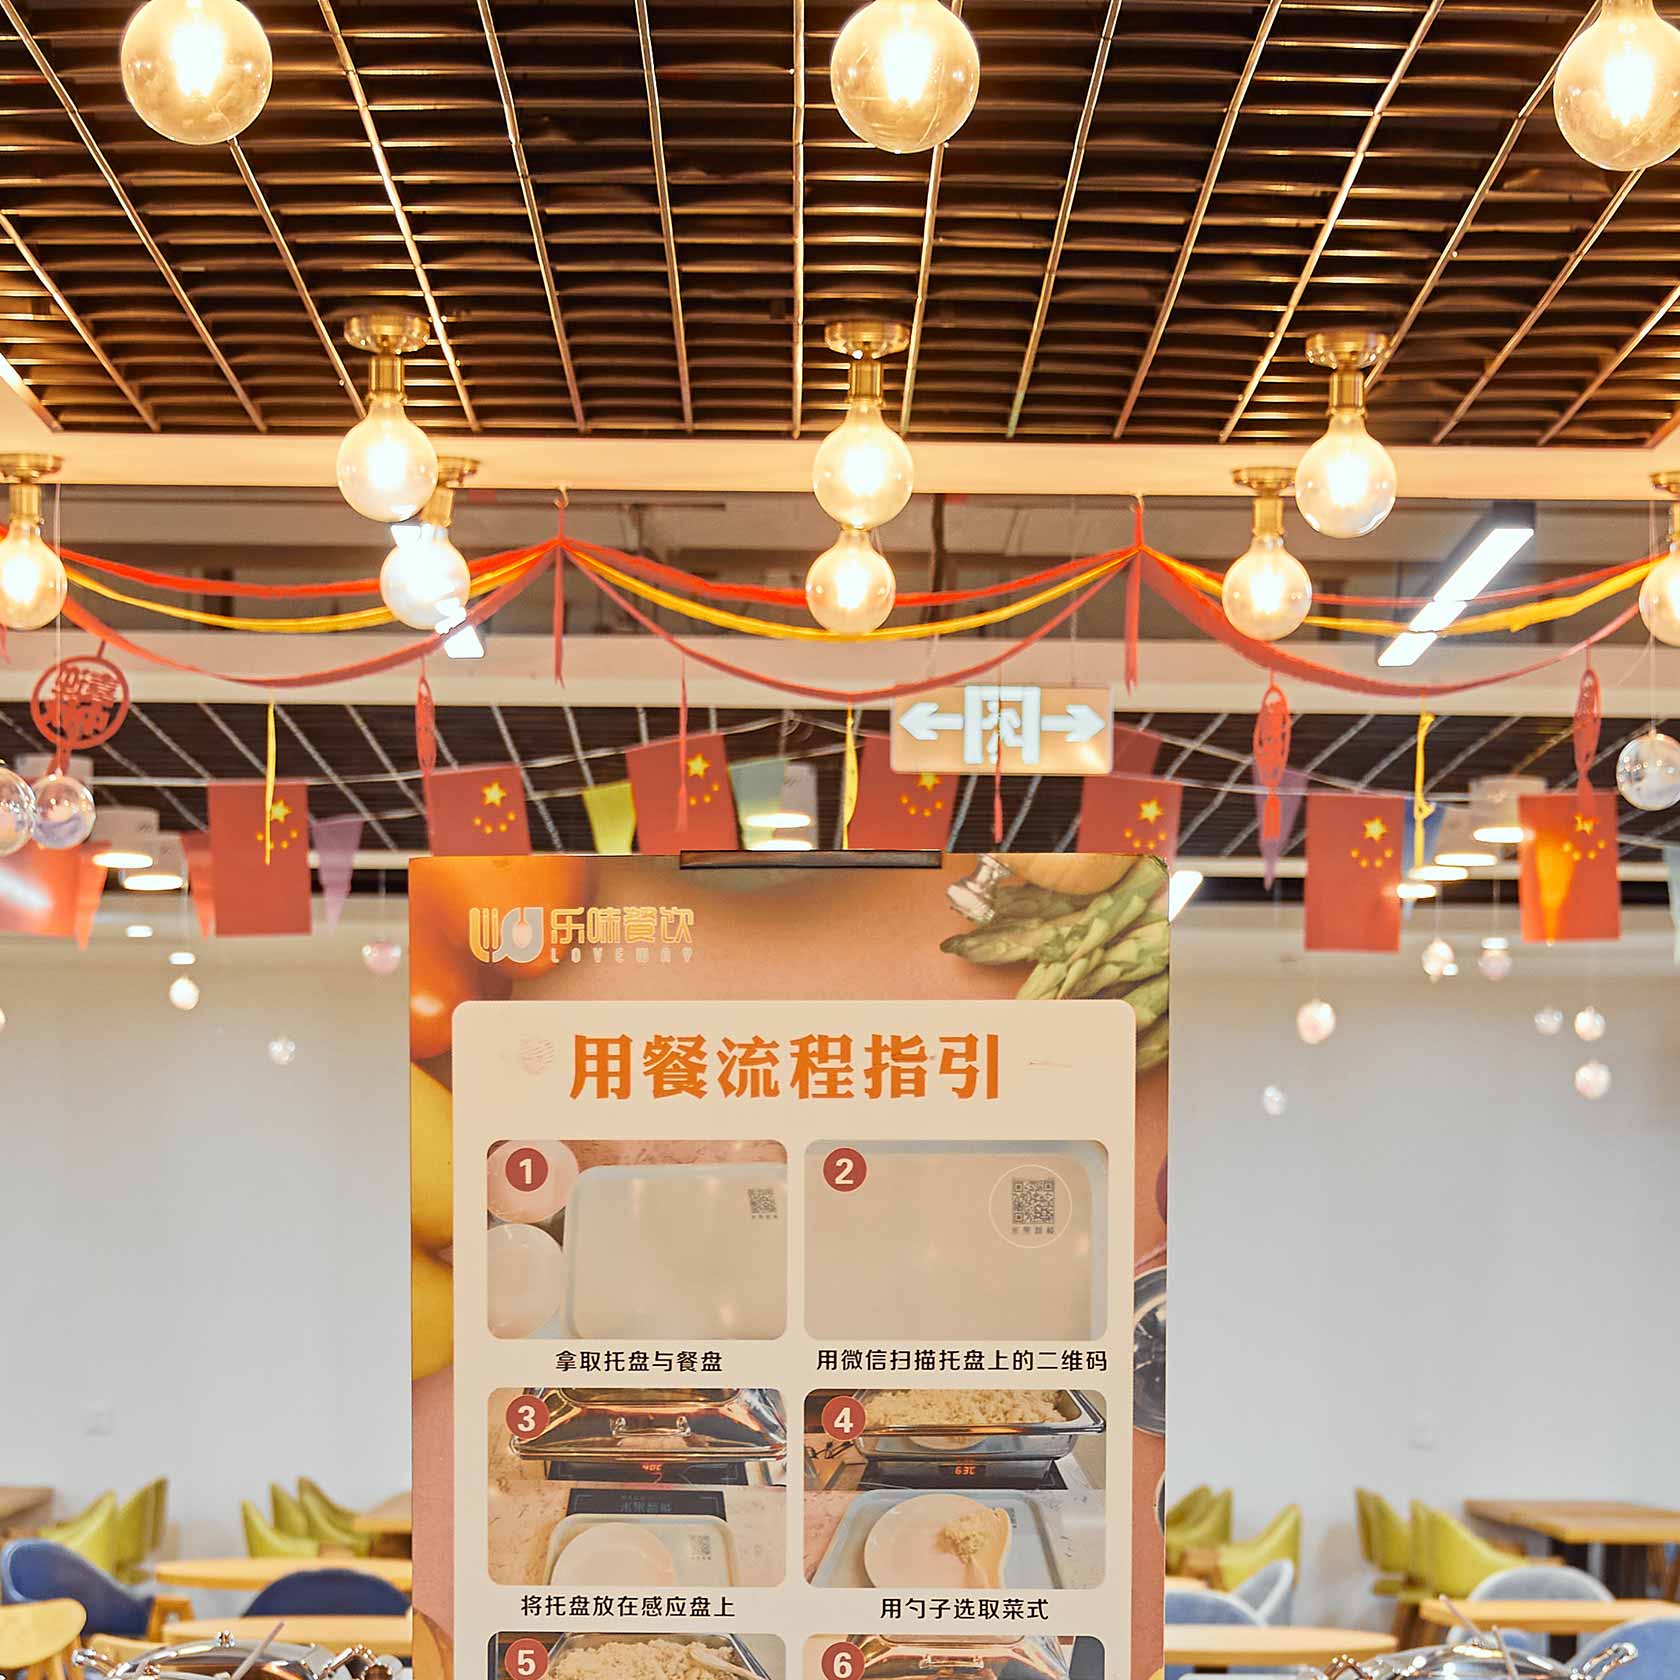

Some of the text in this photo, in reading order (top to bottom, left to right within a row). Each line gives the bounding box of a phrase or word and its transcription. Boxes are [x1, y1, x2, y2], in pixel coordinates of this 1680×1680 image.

[550, 906, 694, 945] 乐味餐饮
[568, 1034, 1001, 1101] 用餐流程指引
[518, 1158, 534, 1185] 1
[833, 1157, 856, 1184] 2
[555, 1350, 723, 1373] 拿取托盘与餐盘
[816, 1349, 1108, 1374] 用微信扫描托盘上的二维码
[516, 1404, 536, 1432] 3
[832, 1406, 855, 1434] 4
[520, 1594, 736, 1619] 将托盘放在感应盘上
[880, 1597, 1050, 1622] 用勺子选取菜式
[516, 1648, 536, 1676] 5
[832, 1652, 852, 1679] 6
